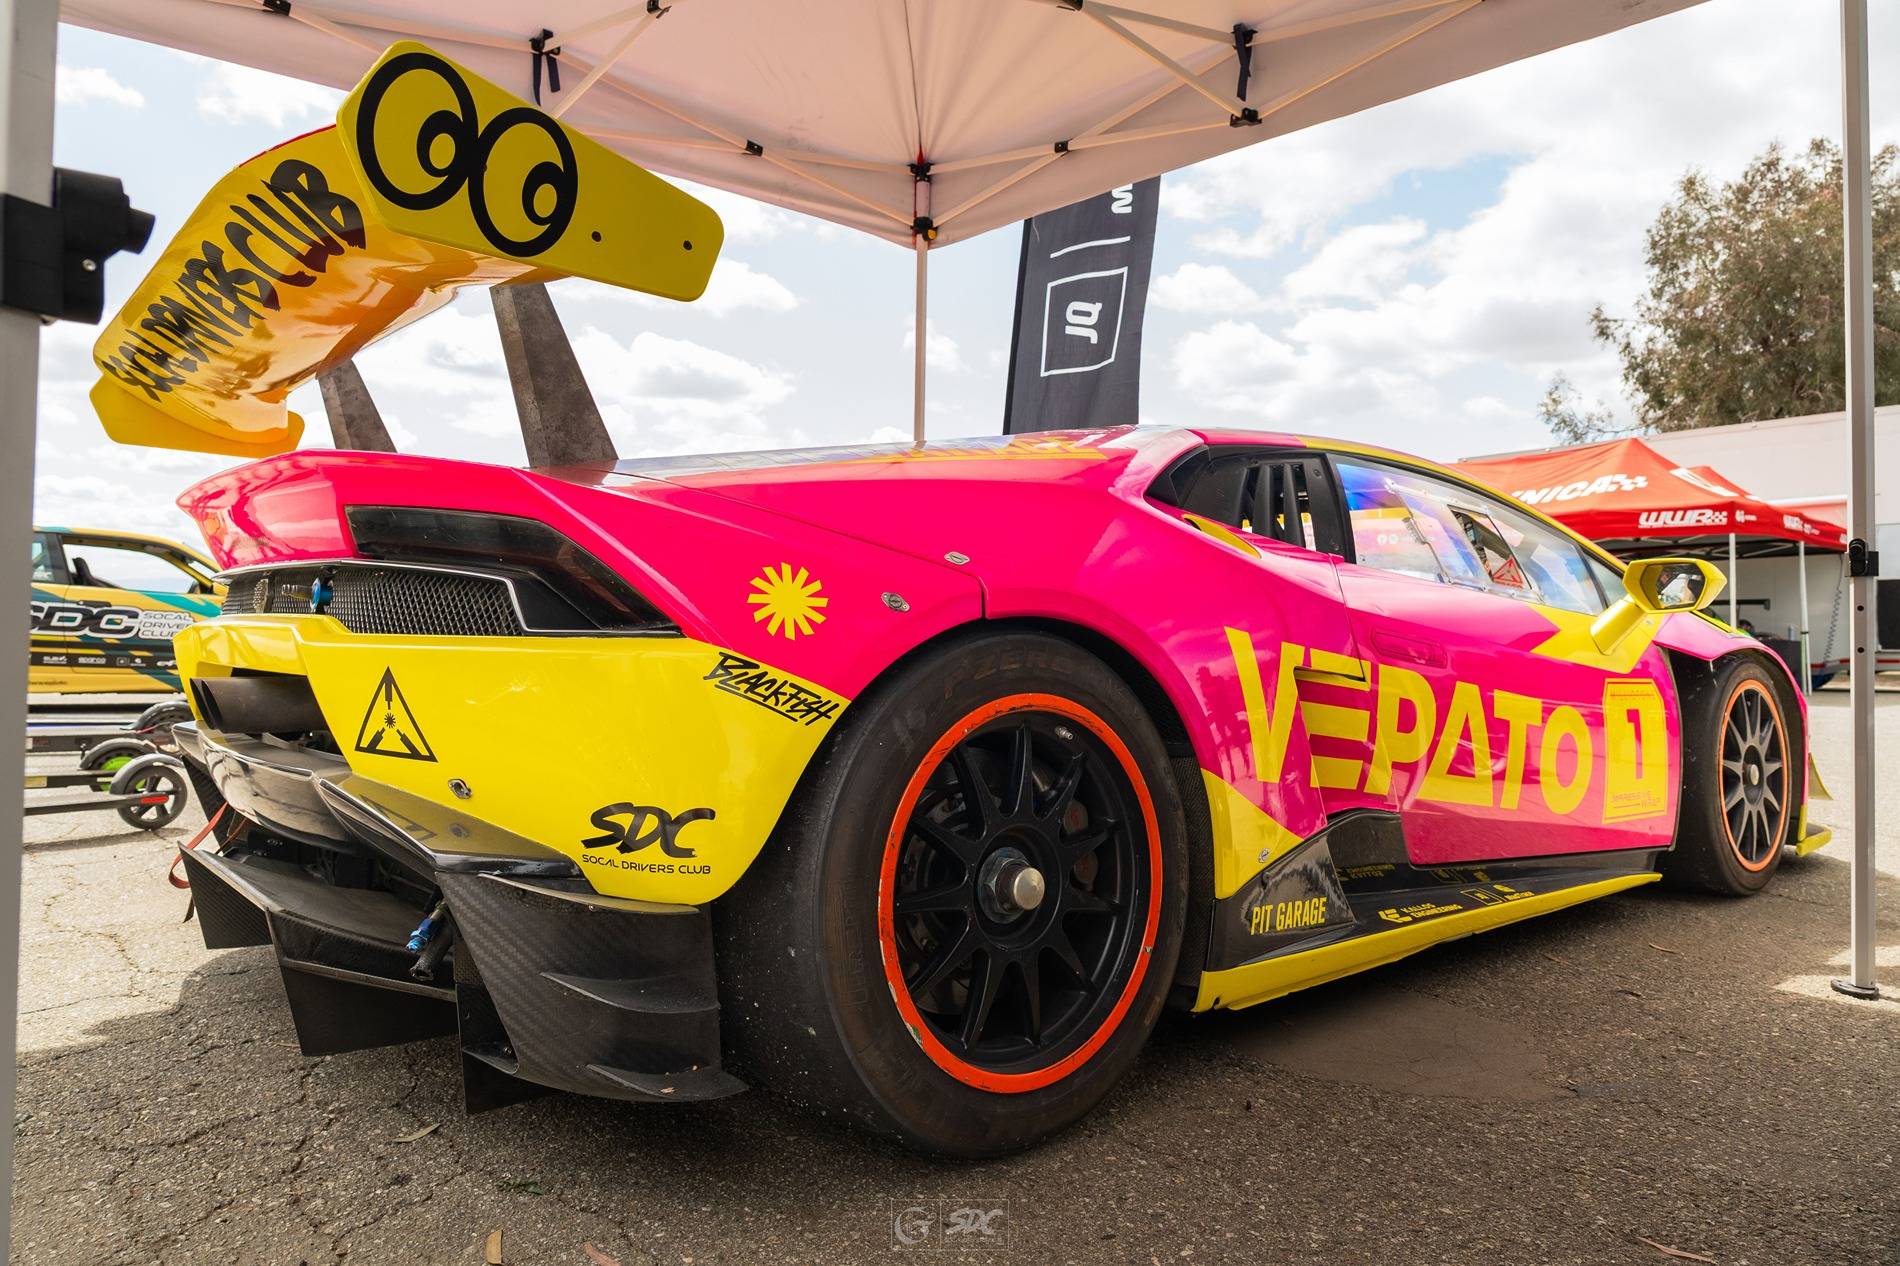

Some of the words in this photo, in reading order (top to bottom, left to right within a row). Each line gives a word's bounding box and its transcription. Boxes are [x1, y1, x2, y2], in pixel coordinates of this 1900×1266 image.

[224, 159, 367, 288] CLUB
[1638, 508, 1714, 528] WWR
[143, 612, 192, 621] SOCAL
[1224, 626, 1593, 815] VEPATO
[581, 802, 716, 859] SDC
[581, 854, 620, 868] SOCAL
[621, 860, 675, 874] DRIVERS
[678, 864, 711, 875] CLUB
[1250, 904, 1274, 936] PIT
[1275, 896, 1328, 932] GARAGE
